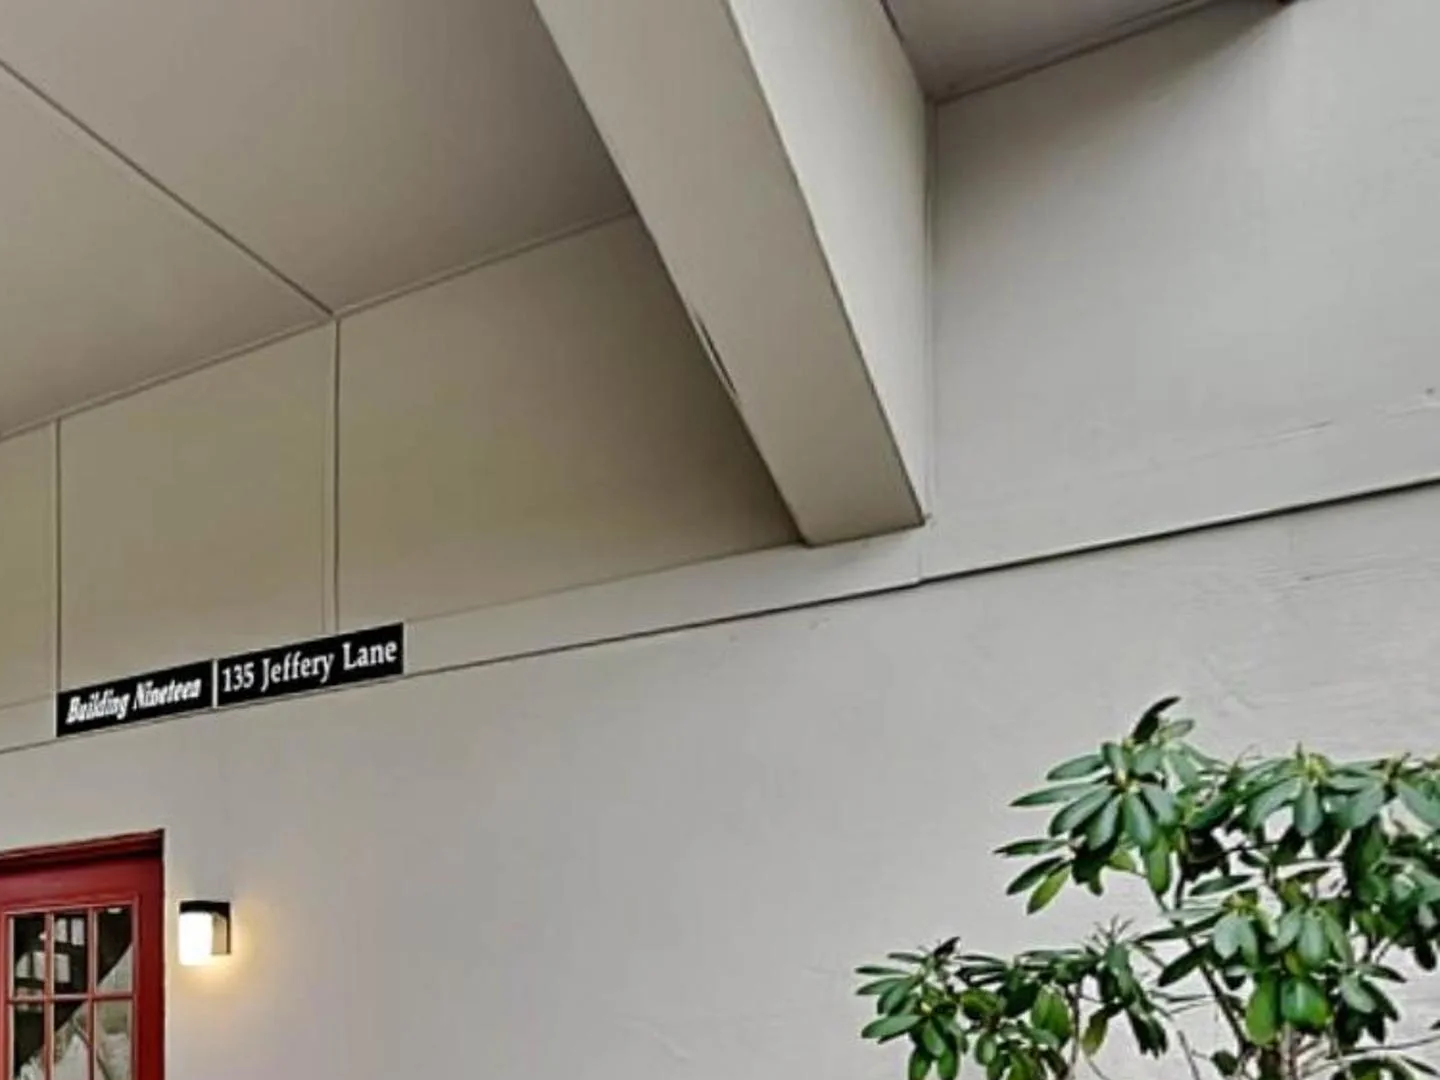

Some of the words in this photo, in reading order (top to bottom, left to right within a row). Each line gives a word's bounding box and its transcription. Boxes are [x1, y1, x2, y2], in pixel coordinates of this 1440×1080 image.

[222, 662, 255, 692] 135
[261, 651, 335, 692] Jeffery
[342, 641, 398, 671] Lane
[65, 689, 130, 724] Building
[132, 679, 201, 711] Nineteen
